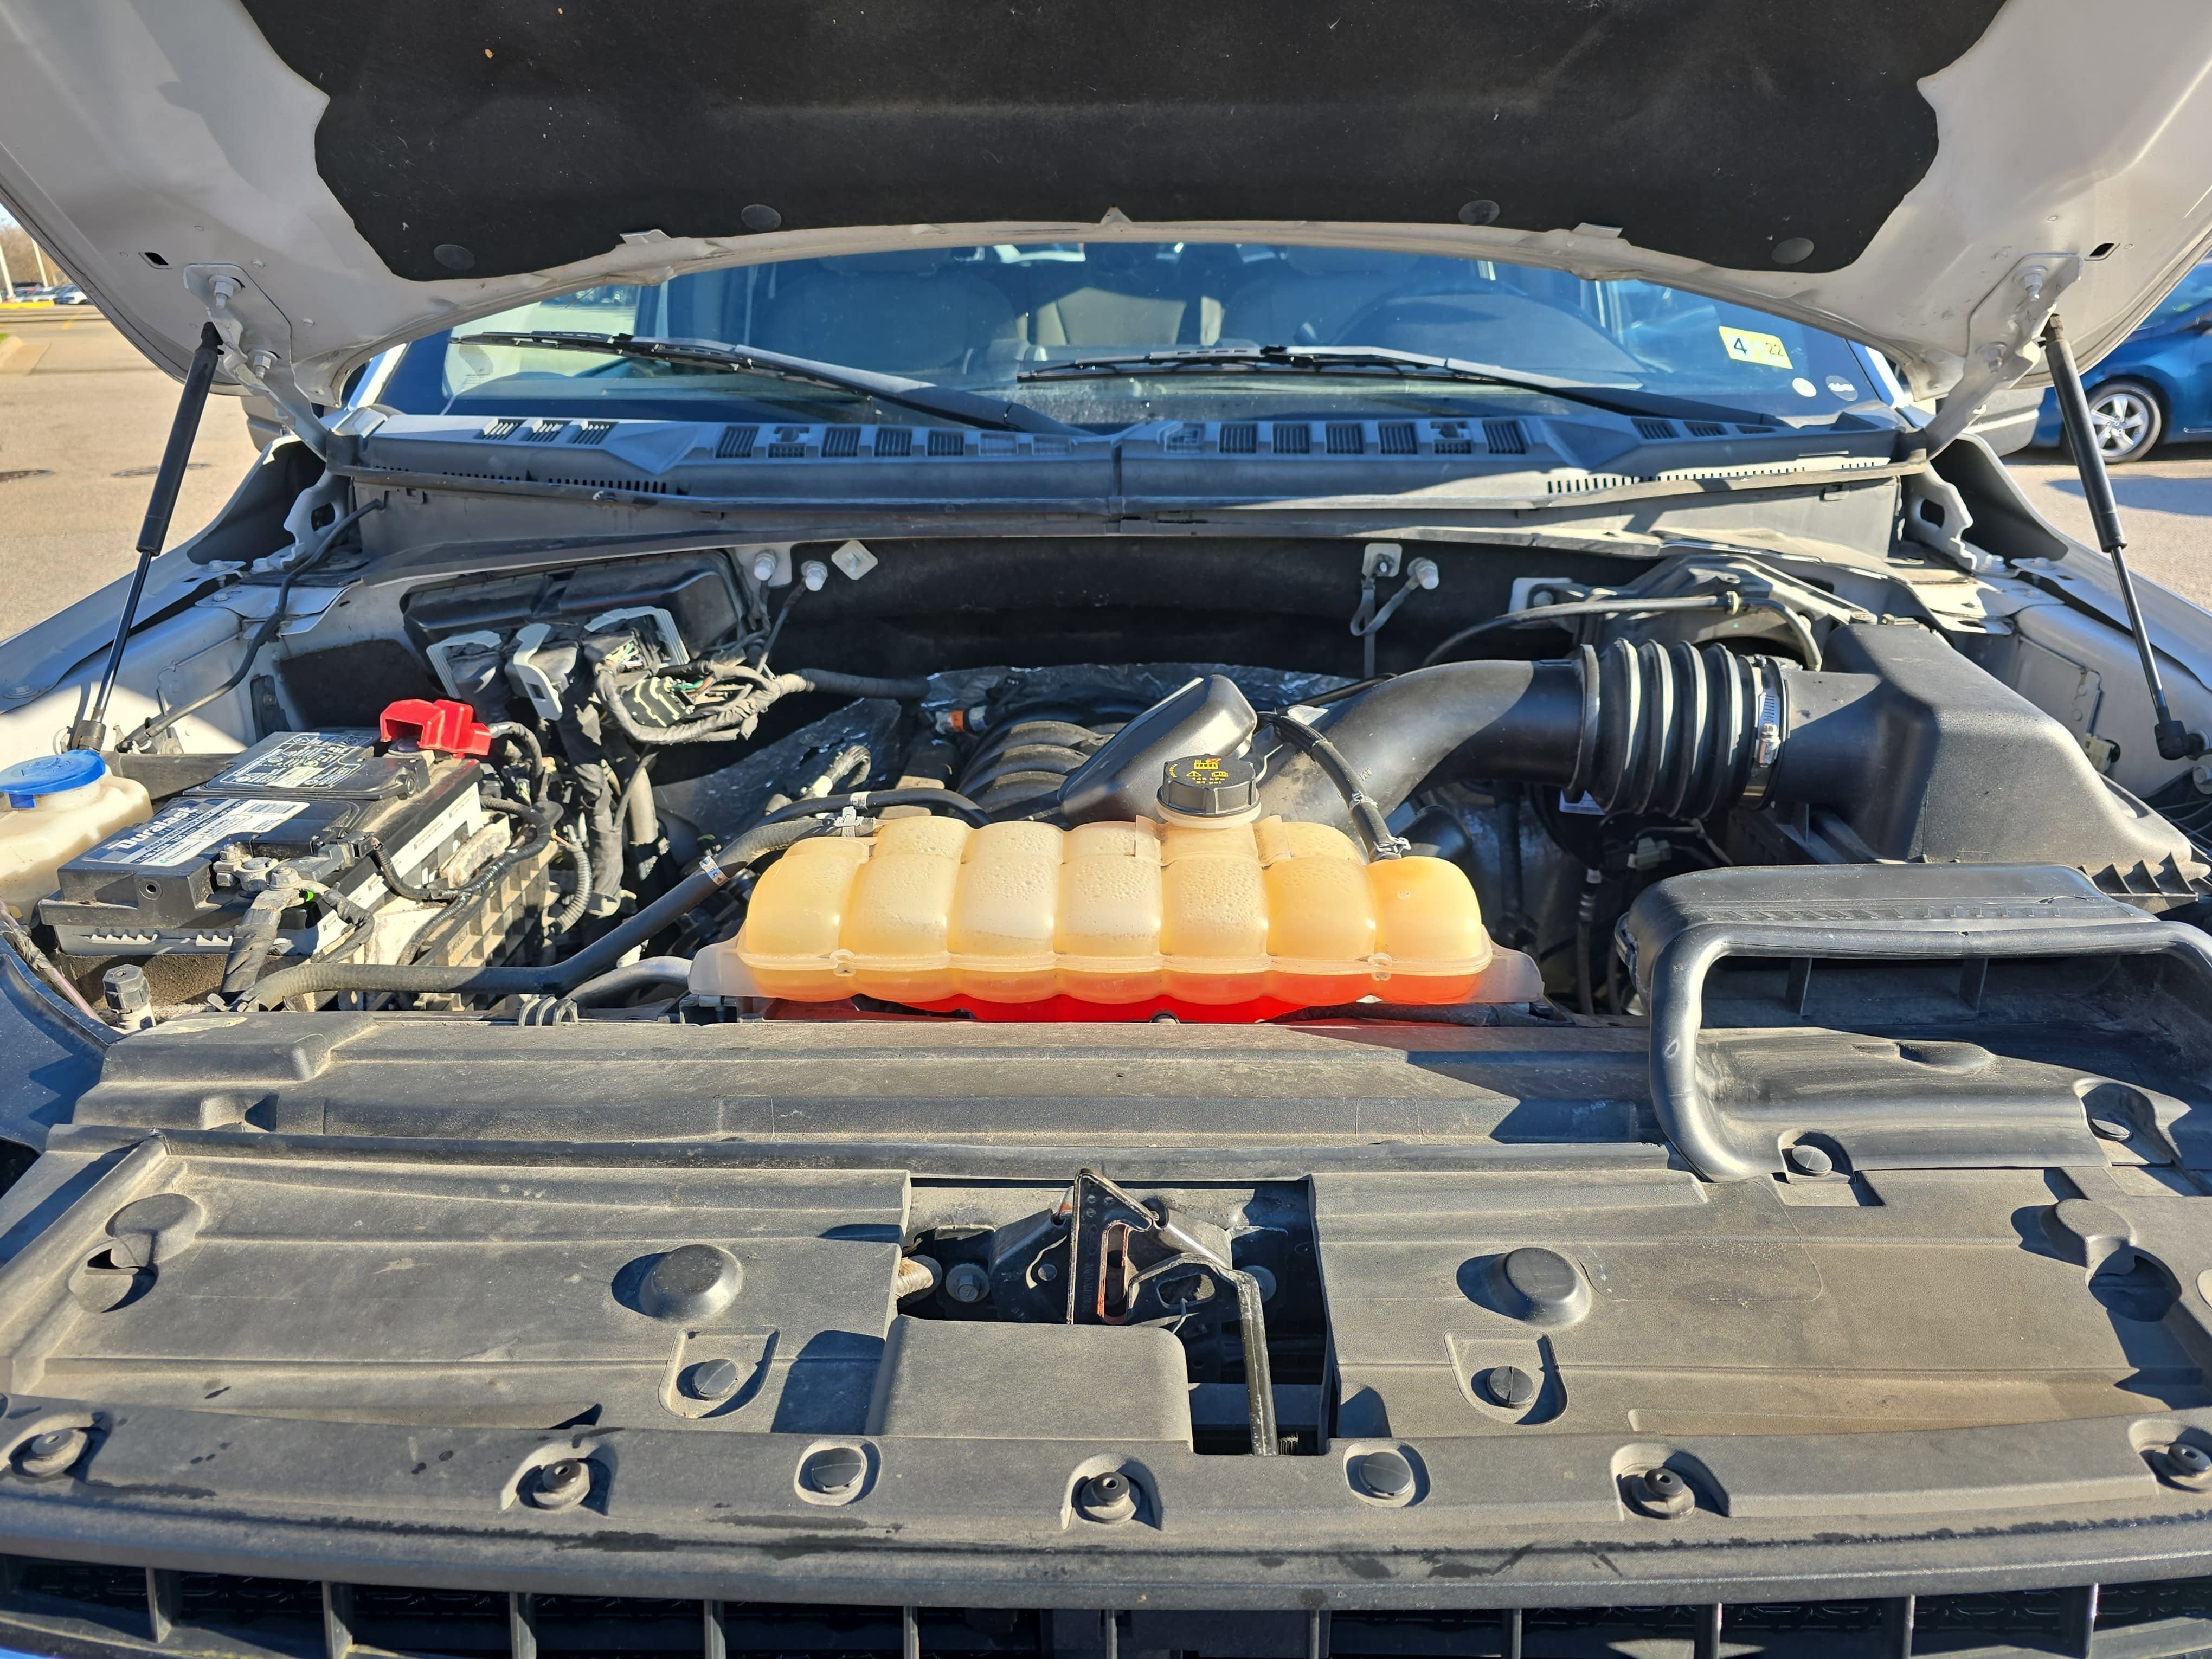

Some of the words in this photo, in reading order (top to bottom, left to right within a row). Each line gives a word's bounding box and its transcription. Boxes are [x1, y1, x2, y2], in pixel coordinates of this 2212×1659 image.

[1734, 338, 1747, 354] 4
[1765, 343, 1785, 357] 22
[106, 807, 198, 850] Duralast
[145, 840, 164, 851] AGM
[164, 811, 213, 839] TECHNOLOGY
